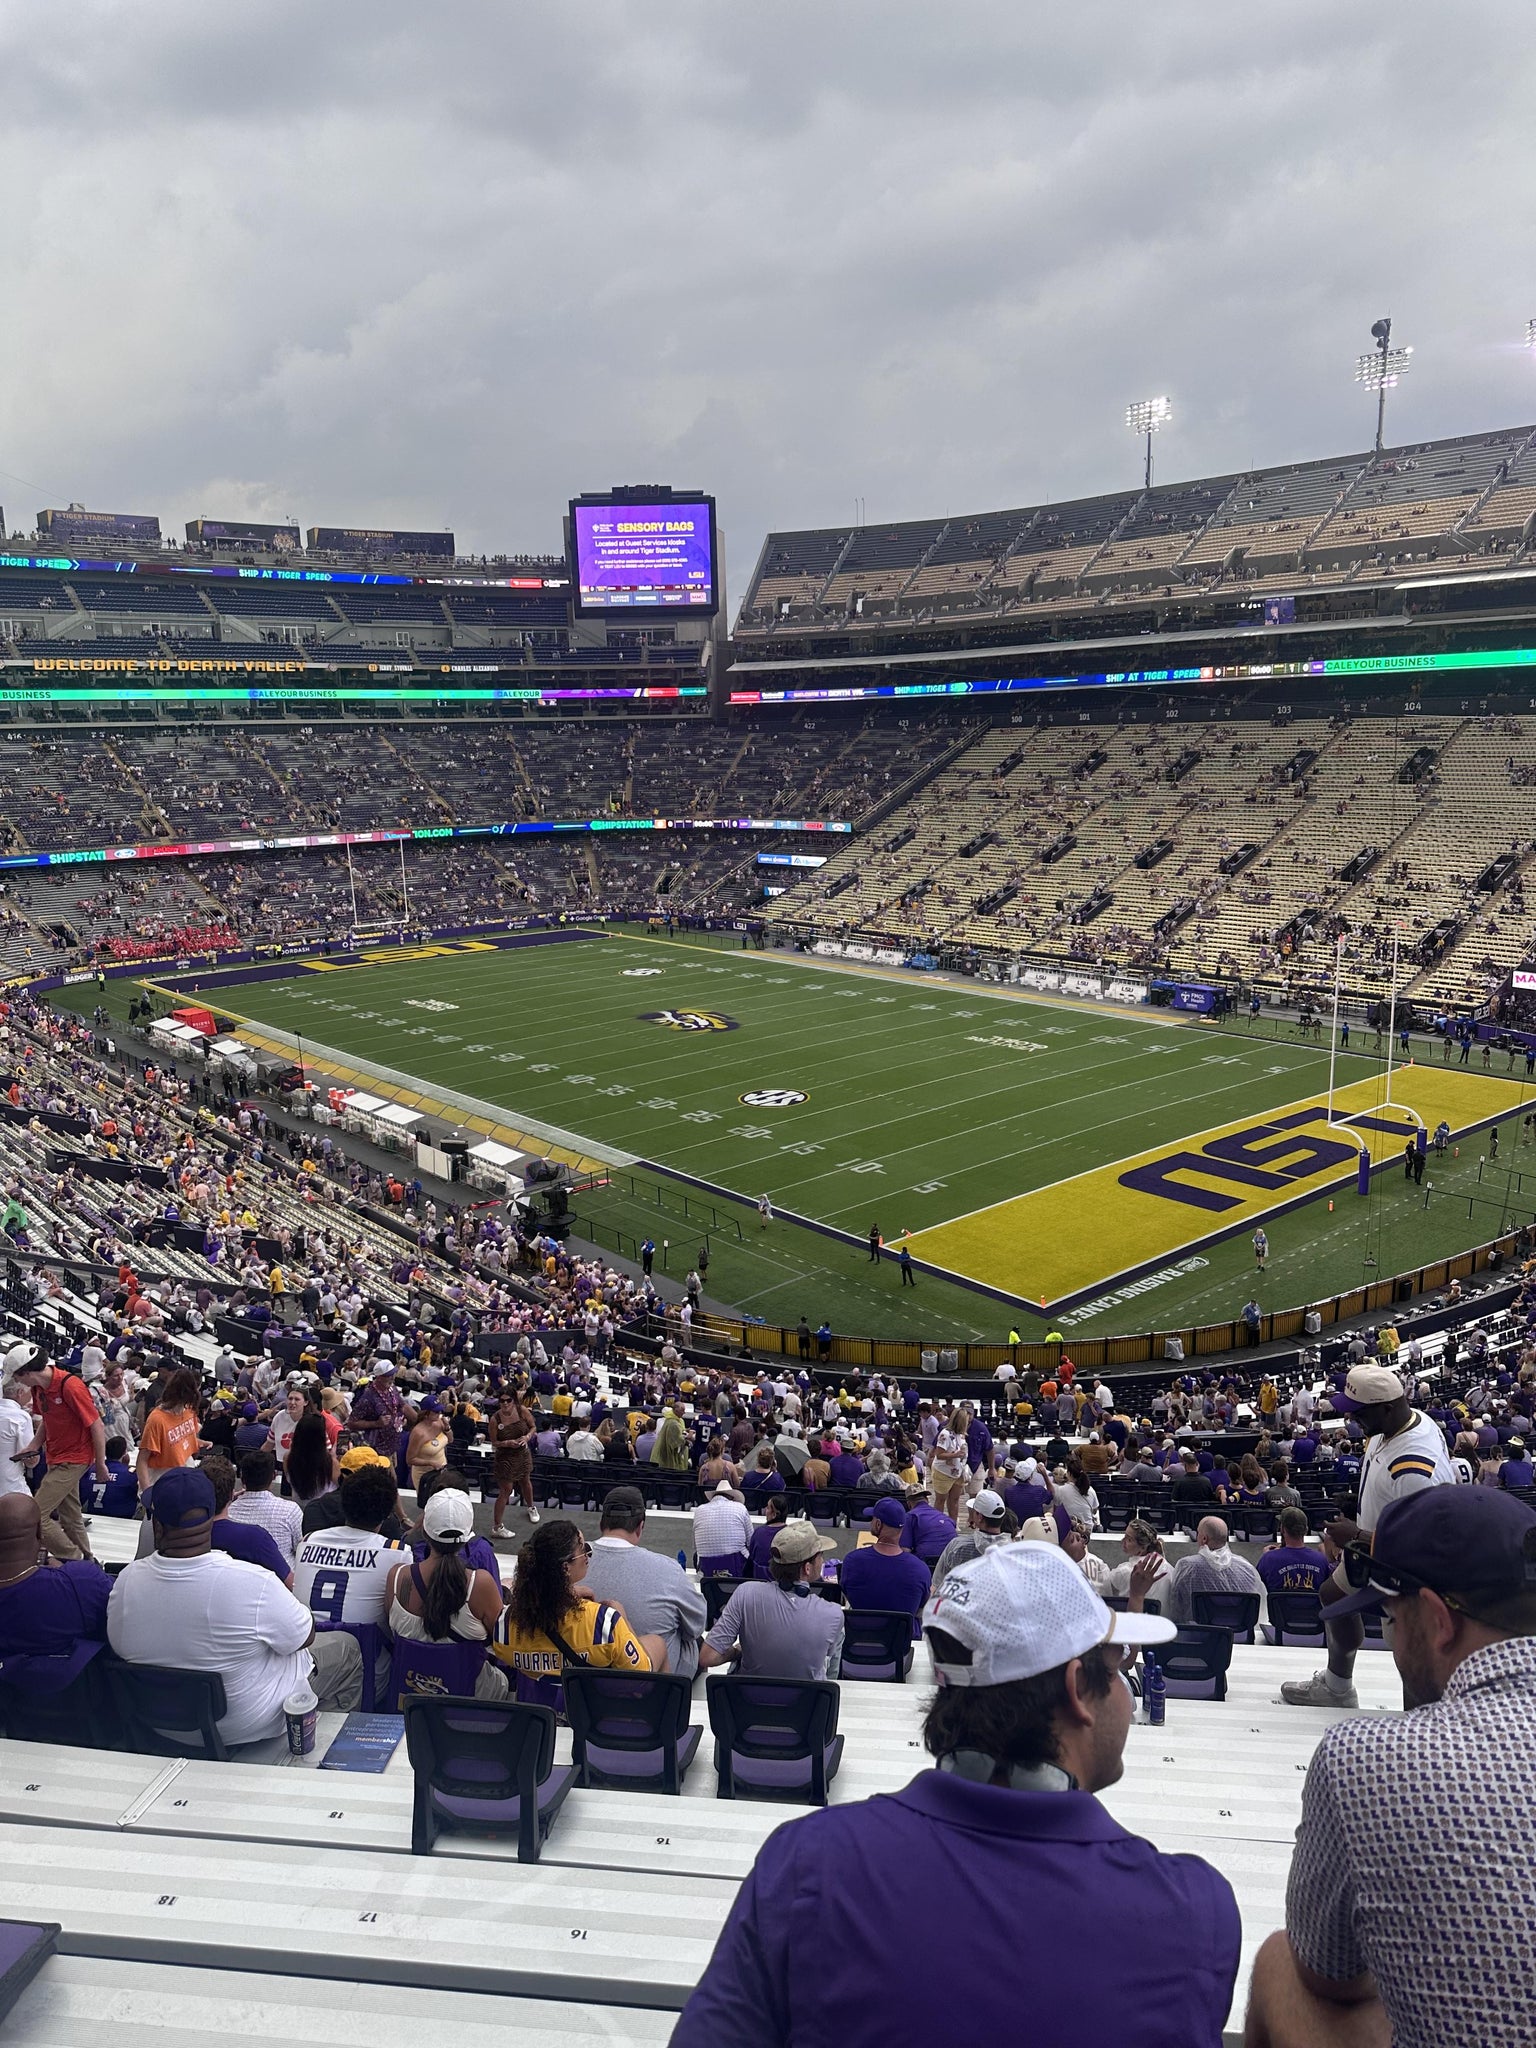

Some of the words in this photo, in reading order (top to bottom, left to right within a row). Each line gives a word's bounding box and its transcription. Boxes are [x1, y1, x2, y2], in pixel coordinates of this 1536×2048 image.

[617, 522, 664, 532] SENSORY
[666, 522, 694, 532] BAGS
[640, 548, 655, 556] Tiger
[0, 557, 30, 566] TIGER
[238, 569, 260, 578] SHIP
[277, 571, 301, 580] TIGER
[34, 658, 139, 671] WELCOME
[146, 660, 171, 672] TO
[178, 660, 237, 672] DEATH
[244, 661, 306, 672] VALLEY
[1302, 663, 1309, 672] 0
[1384, 657, 1436, 668] BUSINESS
[1215, 668, 1221, 676] 0
[1250, 665, 1272, 674] 90:00
[1106, 674, 1124, 682] SHIP
[1128, 673, 1140, 682] AT
[1144, 671, 1168, 680] TIGER
[1174, 669, 1200, 679] SPEED
[894, 686, 910, 695] SHIP
[926, 685, 947, 693] TIGER
[1277, 706, 1292, 714] 103
[1404, 703, 1422, 711] 104
[733, 922, 747, 931] LSU
[281, 947, 310, 956] ORDASH
[298, 941, 499, 972] LSU
[65, 973, 94, 984] BADGER
[596, 1084, 635, 1096] 35
[636, 1097, 678, 1109] 30
[680, 1110, 722, 1124] 25
[726, 1124, 773, 1139] 20
[780, 1141, 826, 1156] 15
[1117, 1106, 1427, 1213] LSU
[834, 1157, 885, 1174] 10
[912, 1181, 949, 1194] 5
[1115, 1268, 1186, 1300] RAISING
[1056, 1295, 1123, 1327] CANE'S
[702, 1426, 711, 1443] 9
[1458, 1464, 1470, 1483] 9
[92, 1484, 107, 1508] 7
[300, 1544, 379, 1569] BURREAUX
[310, 1570, 350, 1622] 9
[624, 1641, 640, 1665] 9
[514, 1651, 590, 1672] BURREX
[26, 1783, 41, 1792] 20
[329, 1811, 344, 1819] 18
[656, 1837, 670, 1845] 16
[158, 1895, 178, 1906] 18
[359, 1912, 378, 1923] 17
[570, 1929, 588, 1940] 16
